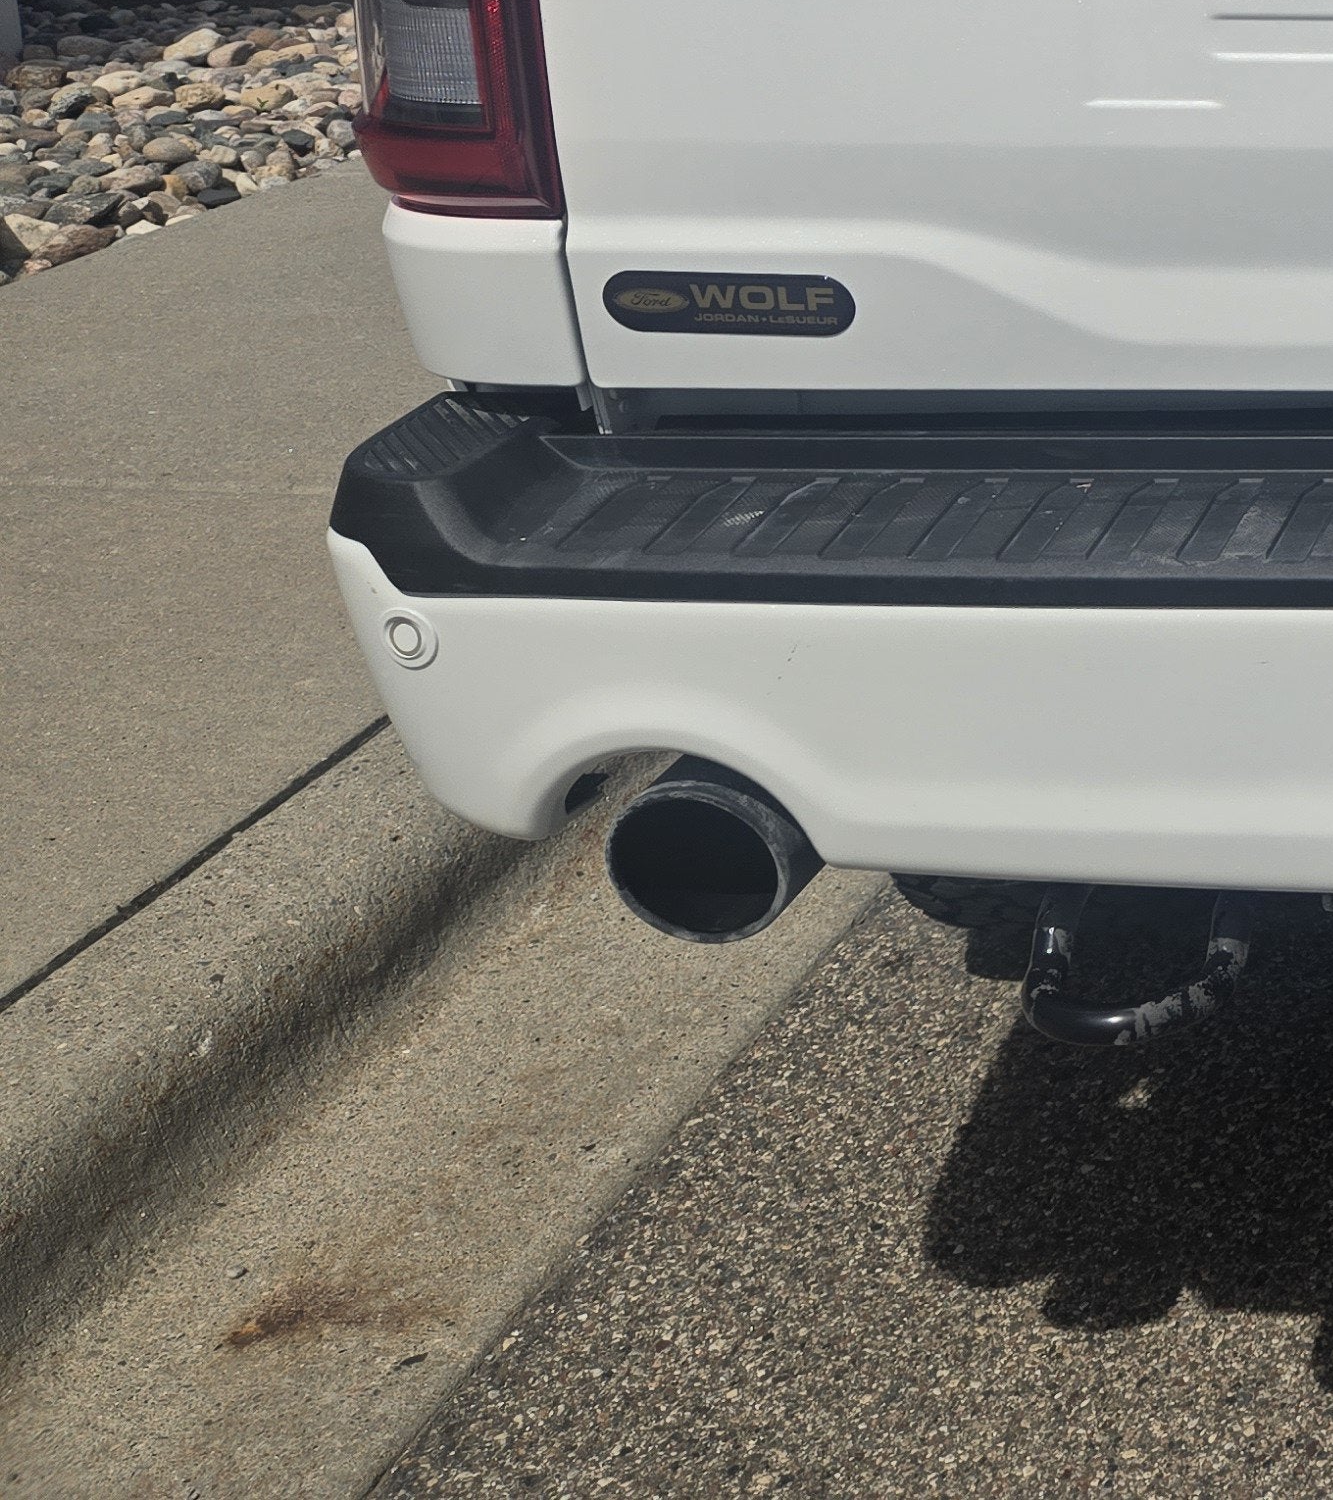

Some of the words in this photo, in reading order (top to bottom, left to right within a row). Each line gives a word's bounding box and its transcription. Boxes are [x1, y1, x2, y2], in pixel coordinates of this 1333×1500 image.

[630, 292, 672, 308] Ford
[689, 284, 834, 311] WOLF
[694, 312, 761, 324] JORDAN
